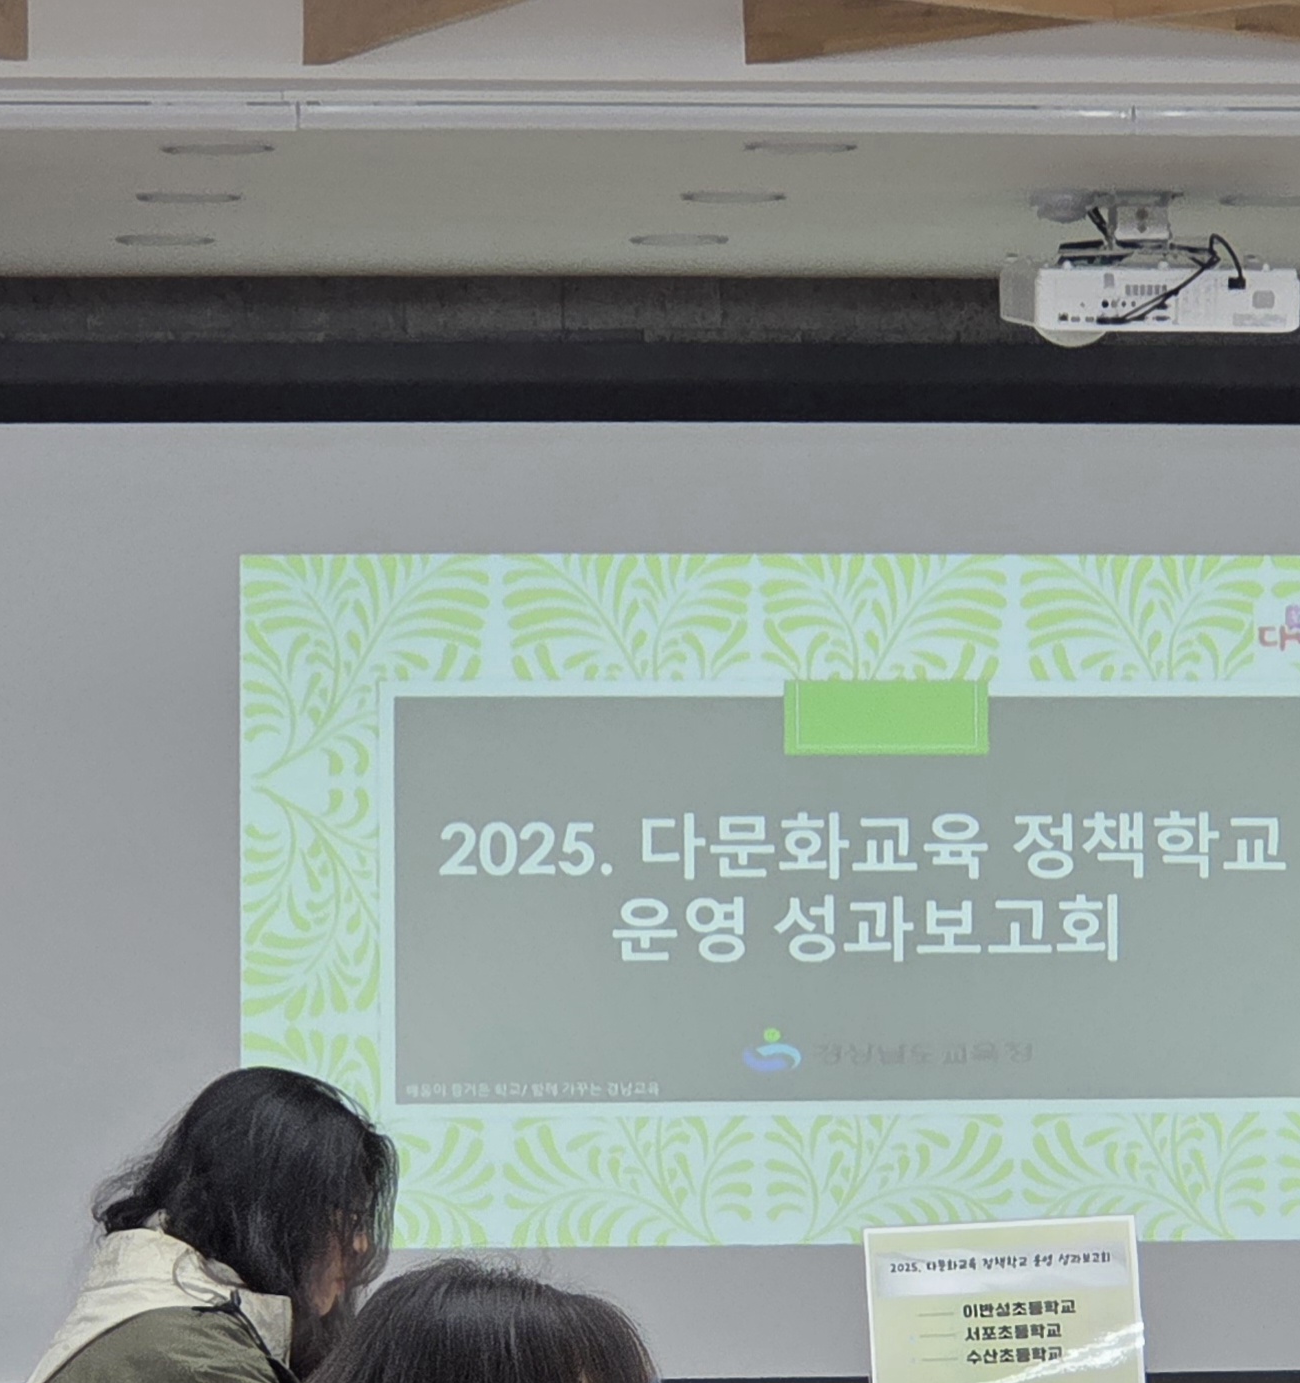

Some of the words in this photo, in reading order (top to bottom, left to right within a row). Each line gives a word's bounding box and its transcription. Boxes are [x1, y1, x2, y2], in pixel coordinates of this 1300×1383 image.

[439, 821, 615, 878] 2025.
[642, 812, 989, 881] 다문화교육
[1013, 811, 1288, 880] 정책학교
[612, 896, 747, 964] 운영
[774, 893, 1120, 963] 성과보고회
[890, 1263, 922, 1273] 2025.
[926, 1258, 977, 1272] 다문화교육
[982, 1256, 1028, 1270] 정책학교
[965, 1323, 1062, 1342] 서포초등학교
[966, 1346, 1063, 1365] 수산초등학교
